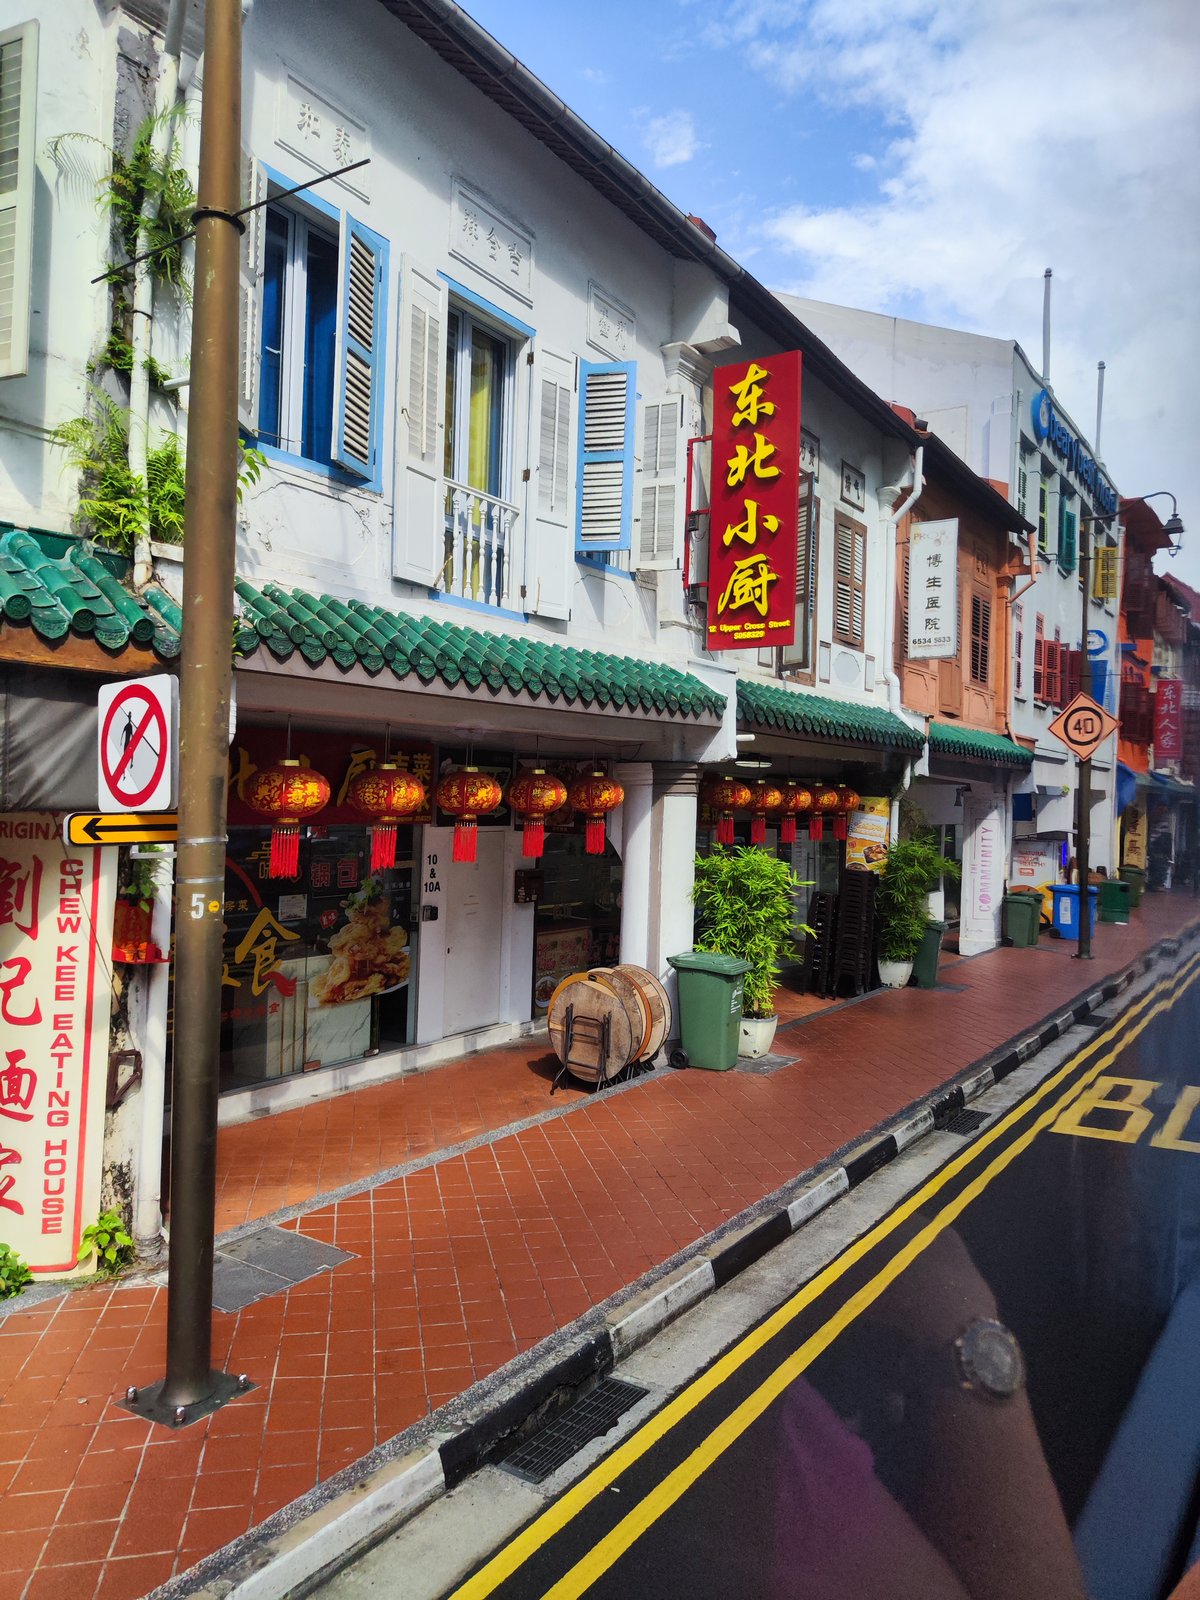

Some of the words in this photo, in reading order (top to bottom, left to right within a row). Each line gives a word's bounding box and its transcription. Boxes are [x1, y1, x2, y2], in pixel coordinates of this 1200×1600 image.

[718, 363, 780, 617] 东北小厨
[925, 553, 943, 631] 博生医院
[708, 625, 717, 633] 12
[719, 624, 742, 632] Upper
[744, 622, 765, 630] Cross
[768, 620, 791, 628] Street
[912, 637, 932, 645] 6534
[1072, 717, 1095, 735] 40
[1159, 684, 1178, 749] 东北人家
[424, 881, 441, 893] 10A
[427, 854, 438, 865] 10
[429, 867, 437, 879] &
[978, 826, 994, 913] COMMUNITY
[57, 859, 84, 934] CHEW
[190, 893, 206, 919] 5
[54, 945, 79, 1002] KEE
[46, 1013, 75, 1128] EATING
[41, 1139, 67, 1235] HOUSE
